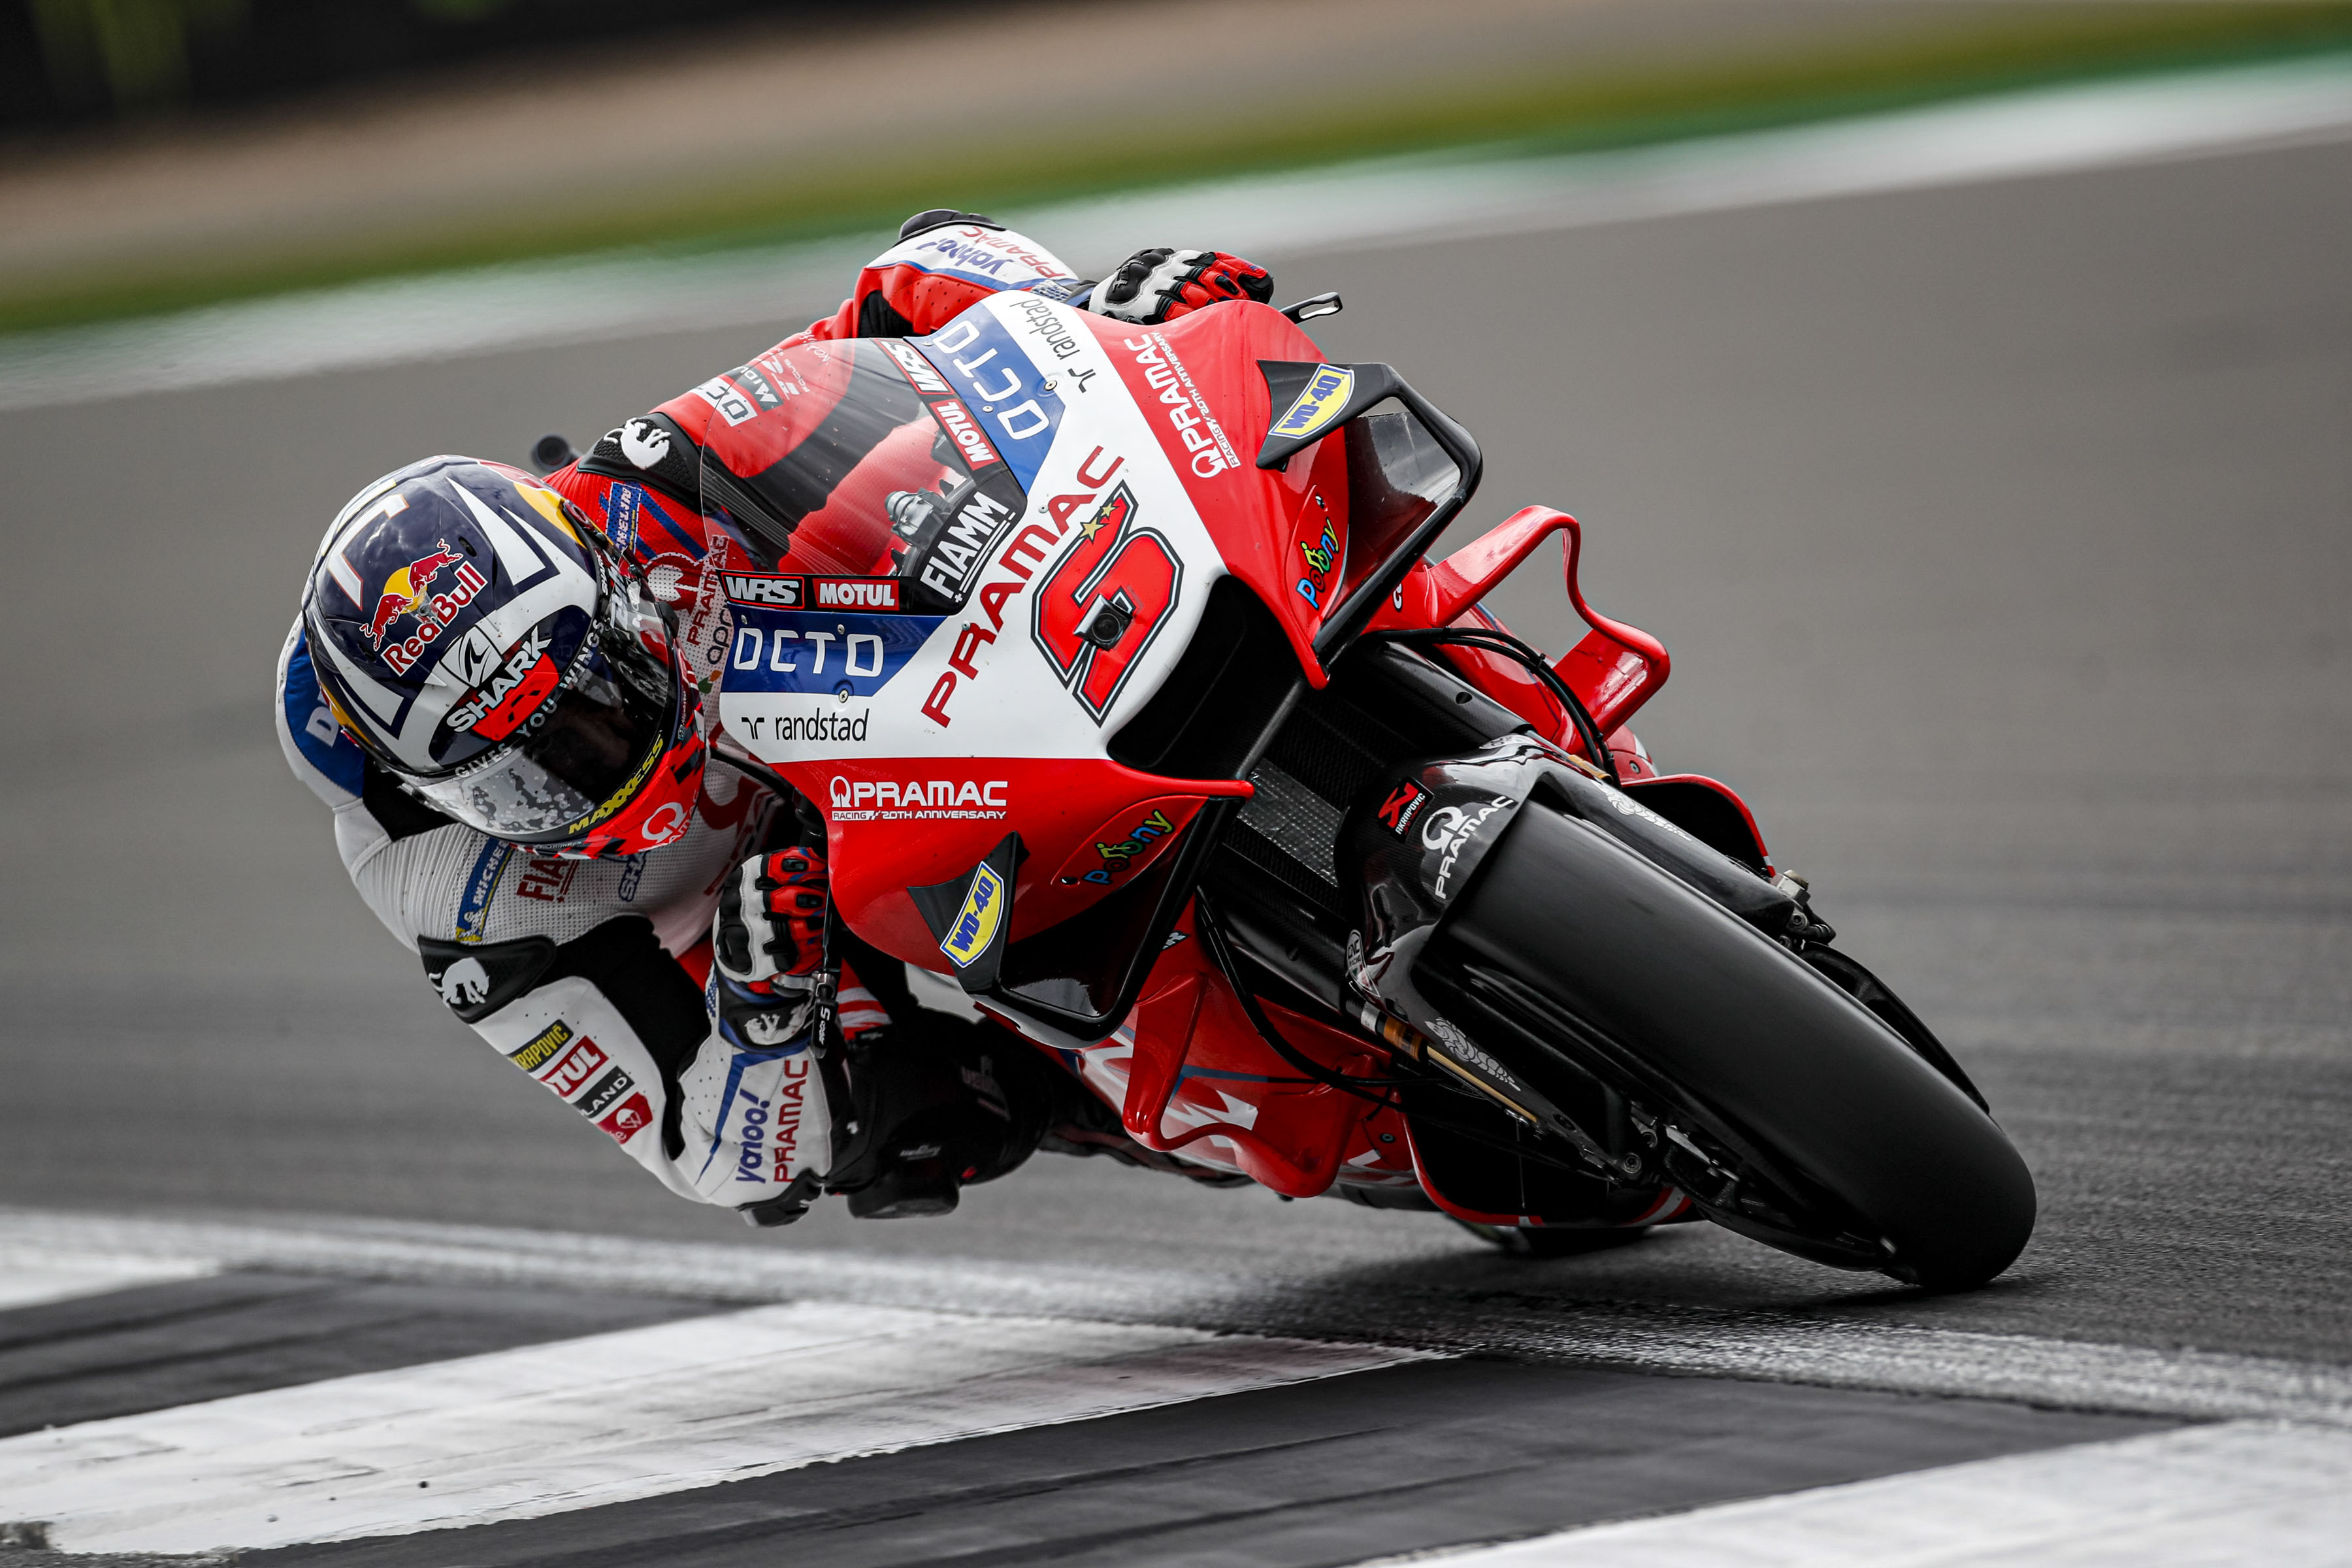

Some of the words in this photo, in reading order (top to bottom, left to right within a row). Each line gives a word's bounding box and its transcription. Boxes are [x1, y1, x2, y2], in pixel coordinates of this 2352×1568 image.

[958, 226, 1067, 279] PRAMAC
[1010, 299, 1083, 360] randstad
[1149, 330, 1195, 389] ANNIVERSARY
[783, 358, 811, 393] FOCUS
[885, 340, 951, 391] WRS
[932, 320, 1050, 440] OCTO
[1123, 333, 1214, 453] PRAMAC
[936, 401, 995, 463] MOTUL
[1188, 388, 1211, 416] 20TH
[1280, 374, 1342, 429] WD-40
[1212, 426, 1239, 466] RACING
[919, 491, 1009, 599] FIAMM
[687, 534, 730, 646] PRAMAC
[725, 576, 800, 604] WRS
[819, 582, 896, 607] MOTUL
[921, 444, 1125, 728] PRAMAC
[1030, 479, 1184, 729] 5
[381, 613, 442, 676] Red
[429, 561, 488, 627] Bull
[446, 625, 553, 732] SHARK
[733, 627, 884, 678] OCTO
[455, 742, 512, 779] GIVES
[515, 698, 558, 738] YOU
[559, 619, 605, 691] WINGS
[776, 707, 870, 742] randstad
[568, 733, 664, 835] MAXXESS
[833, 811, 868, 820] RACING
[882, 810, 912, 820] 20TH
[915, 810, 1007, 820] ANNIVERSARY
[853, 781, 1008, 808] PRAMAC
[1435, 795, 1515, 900] PRAMAC
[951, 875, 994, 953] WD-40
[774, 1059, 809, 1183] PRAMAC
